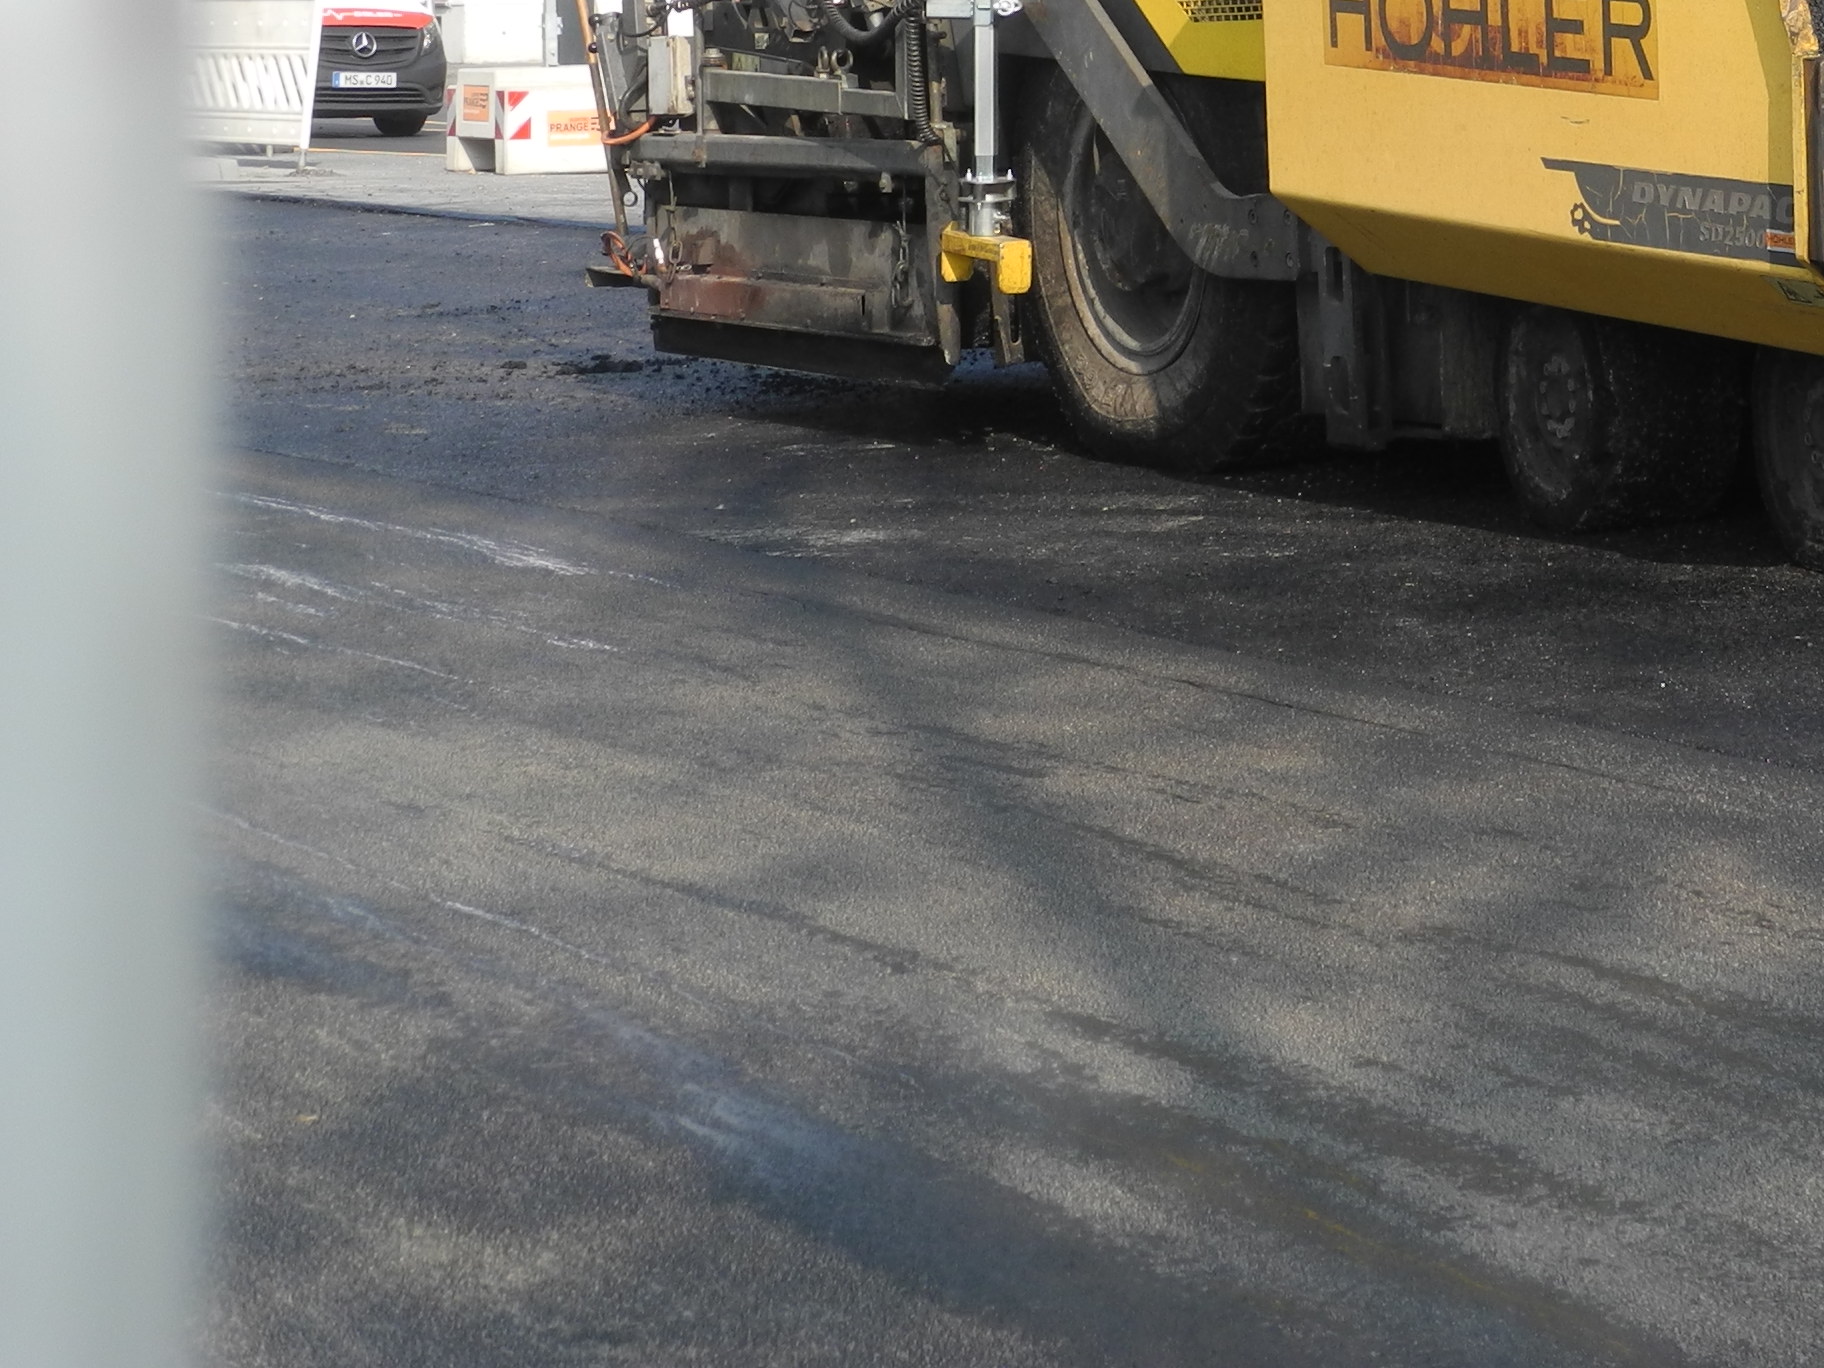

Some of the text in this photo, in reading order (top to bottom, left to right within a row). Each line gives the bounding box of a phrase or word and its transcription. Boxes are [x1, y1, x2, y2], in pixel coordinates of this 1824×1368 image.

[344, 74, 393, 86] MS C 940
[550, 122, 589, 132] PRANGE
[1632, 181, 1794, 224] DYNAPAC
